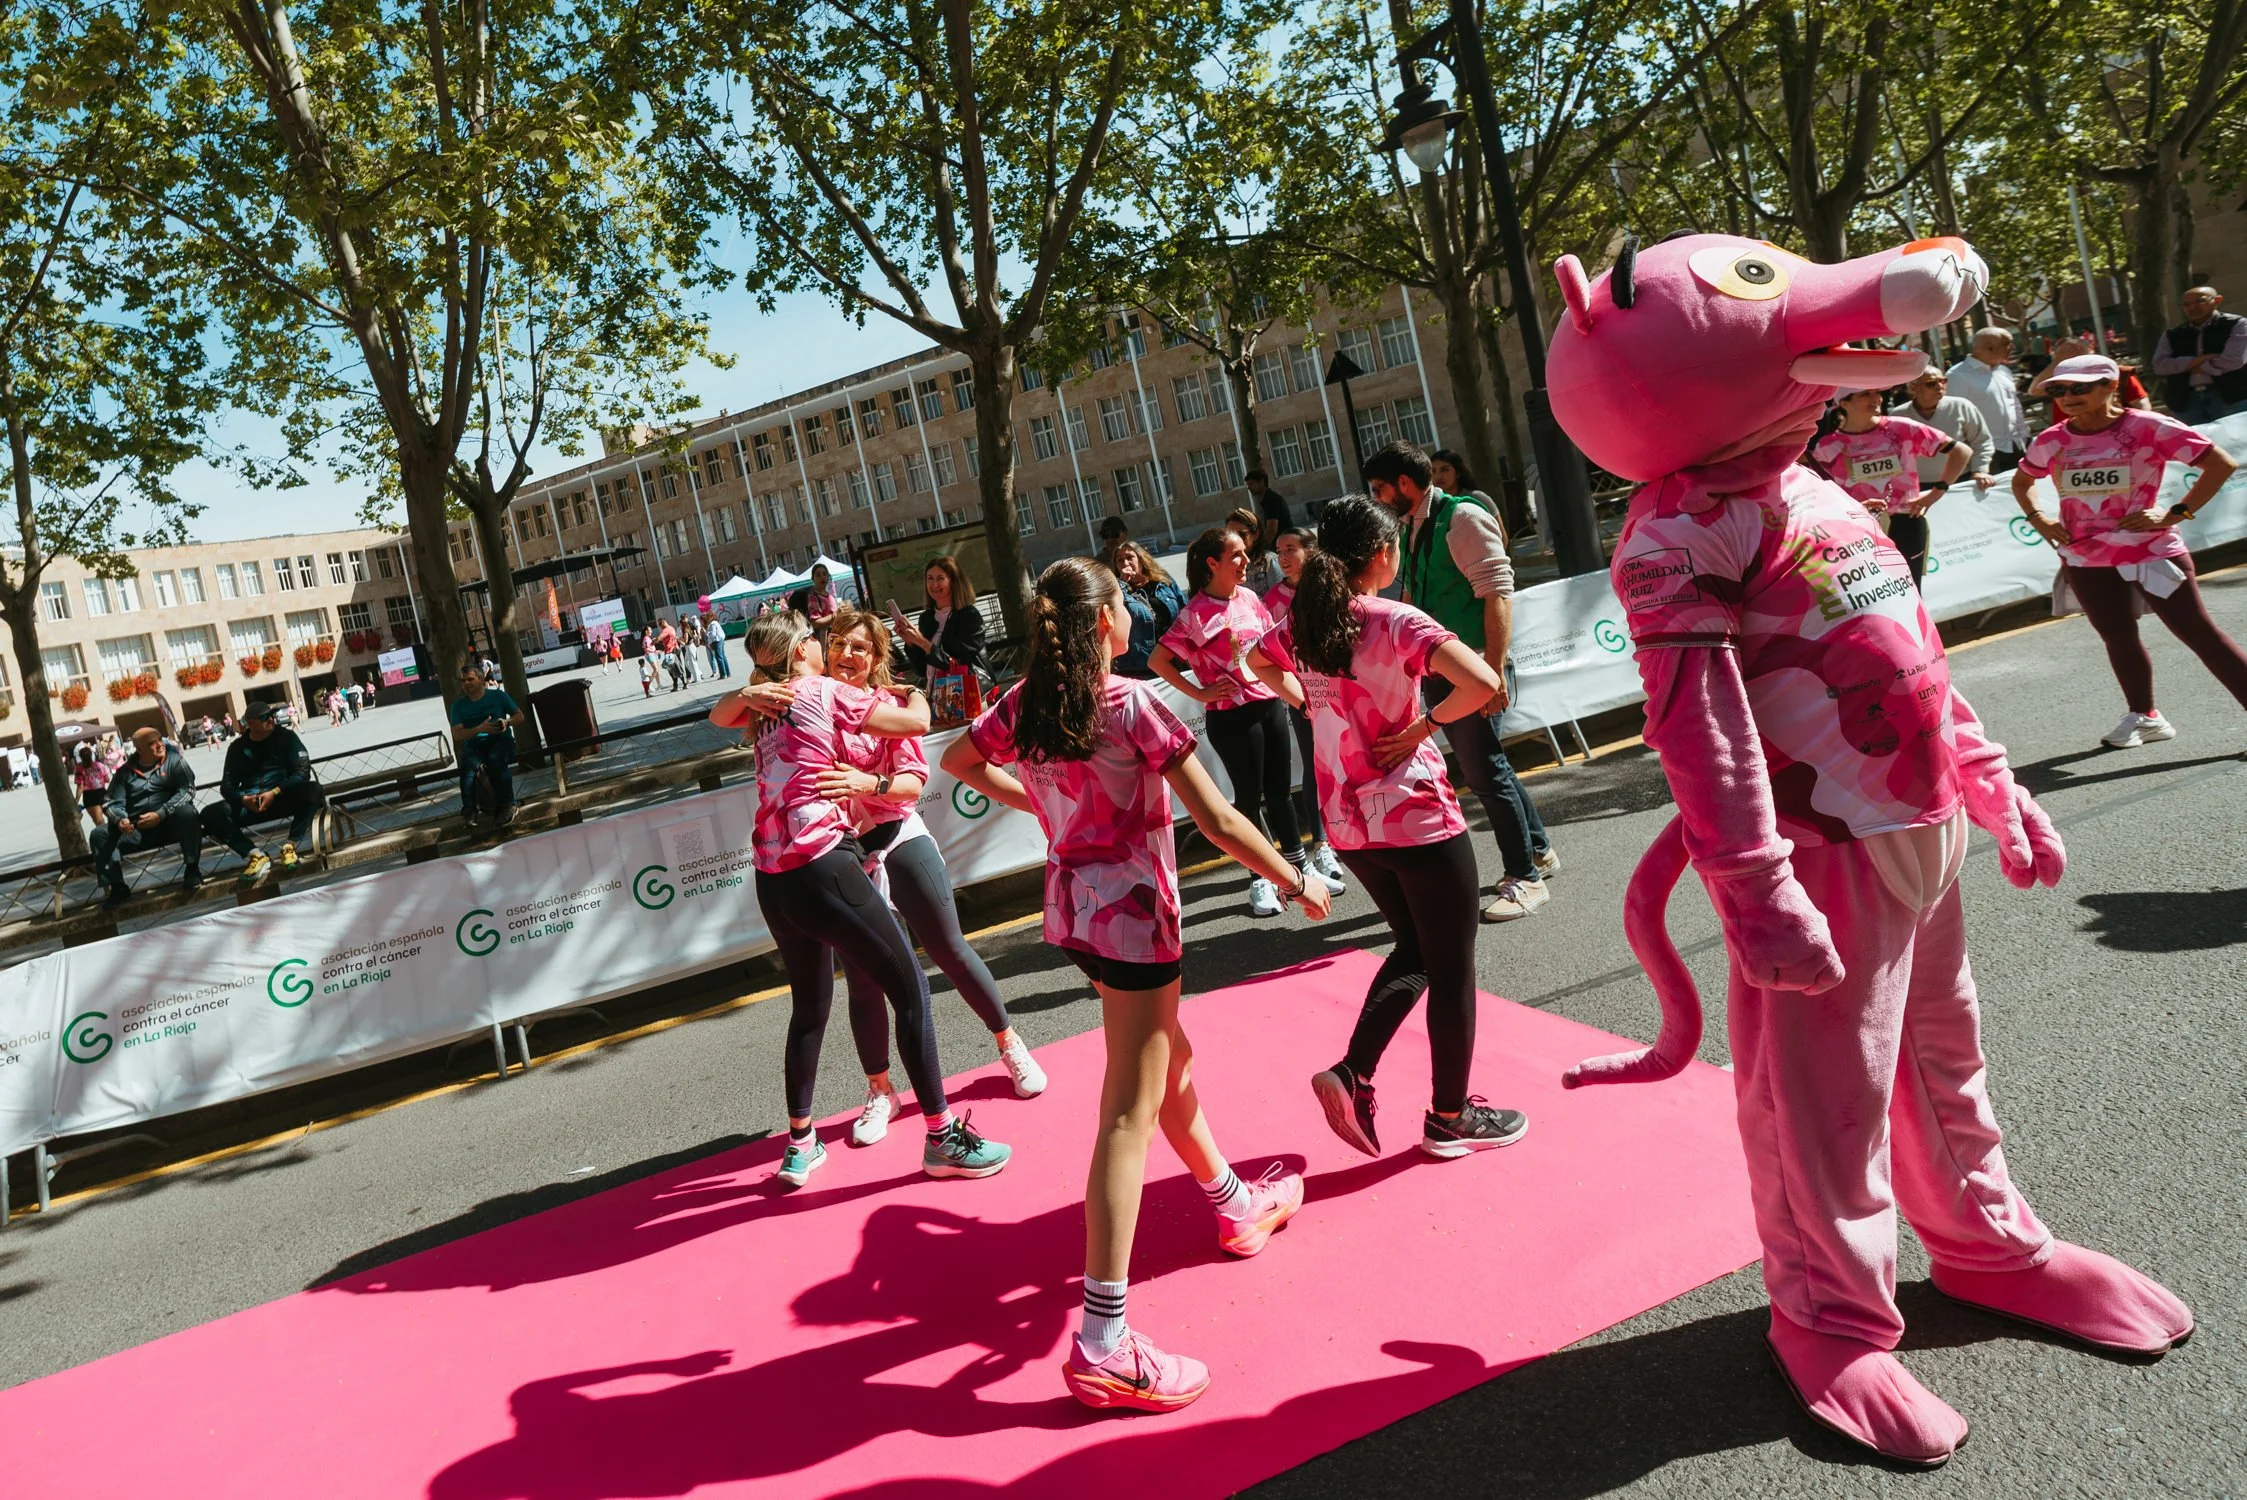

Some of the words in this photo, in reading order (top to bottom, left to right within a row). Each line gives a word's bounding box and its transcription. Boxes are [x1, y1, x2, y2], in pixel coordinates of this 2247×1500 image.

[1862, 459, 1894, 474] 8178
[2071, 470, 2120, 487] 6486
[1807, 524, 1831, 544] XI
[1822, 536, 1876, 564] Carrera
[1627, 565, 1692, 588] HUMILDAD
[1836, 566, 1867, 592] por
[1867, 560, 1881, 576] la
[1630, 583, 1655, 598] RUIZ
[1846, 573, 1914, 611] Investigac
[523, 657, 545, 669] ogroño
[1516, 652, 1543, 664] contra
[678, 850, 736, 872] asociación
[681, 868, 717, 885] contra
[719, 863, 729, 875] el
[731, 858, 755, 871] cán
[506, 894, 568, 917] asociación
[570, 880, 622, 900] española
[683, 888, 698, 898] en
[700, 884, 714, 894] La
[716, 875, 743, 890] Rioja
[508, 913, 547, 930] contra
[549, 908, 560, 920] el
[562, 899, 602, 916] cáncer
[510, 933, 525, 944] en
[528, 929, 542, 940] La
[544, 920, 574, 936] Rioja
[321, 940, 387, 966] asociación
[389, 925, 445, 947] española
[322, 962, 363, 980] contra
[366, 955, 377, 968] el
[380, 946, 422, 964] cáncer
[323, 982, 339, 994] en
[343, 977, 358, 989] La
[361, 968, 392, 985] Rioja
[121, 990, 193, 1019] asociación
[196, 975, 256, 1001] española
[123, 1013, 167, 1034] contra
[170, 1008, 182, 1021] el
[185, 996, 231, 1017] cáncer
[0, 1030, 51, 1054] pañola
[124, 1037, 141, 1049] en
[144, 1031, 161, 1043] La
[164, 1020, 197, 1039] Rioja
